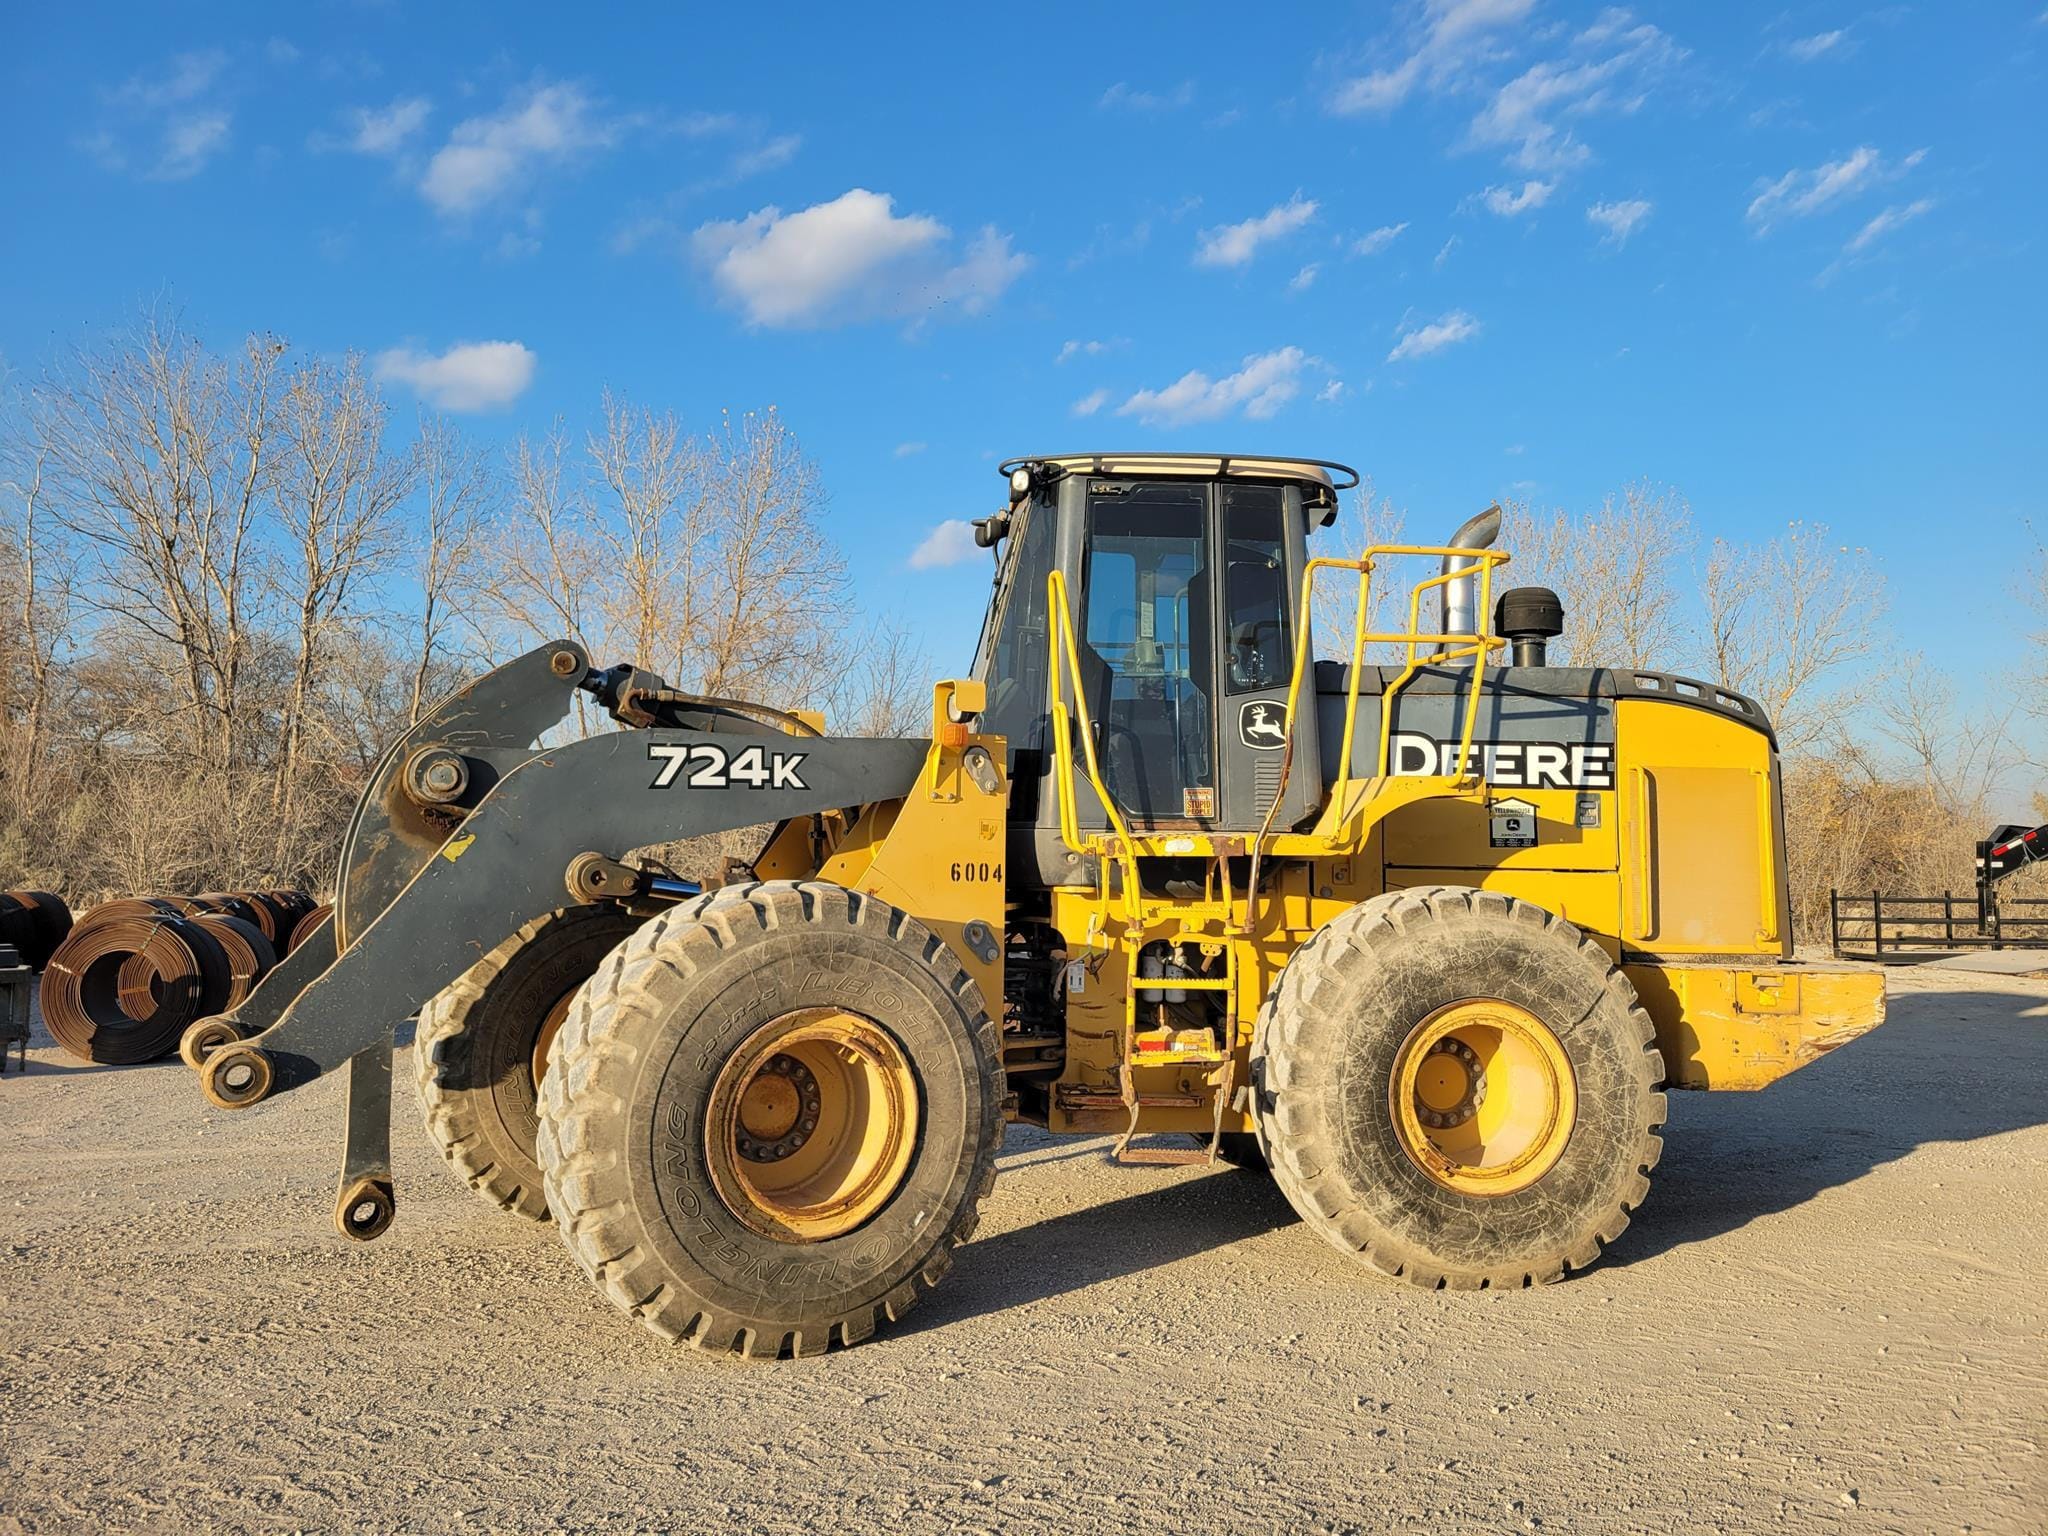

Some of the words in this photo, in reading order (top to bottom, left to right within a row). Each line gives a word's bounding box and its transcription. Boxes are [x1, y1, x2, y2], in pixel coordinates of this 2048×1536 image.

[648, 744, 810, 789] 724K
[1390, 734, 1610, 787] DEERE
[1187, 800, 1210, 809] STUPID
[950, 862, 1003, 883] 6004
[664, 1101, 839, 1286] LINGLONG
